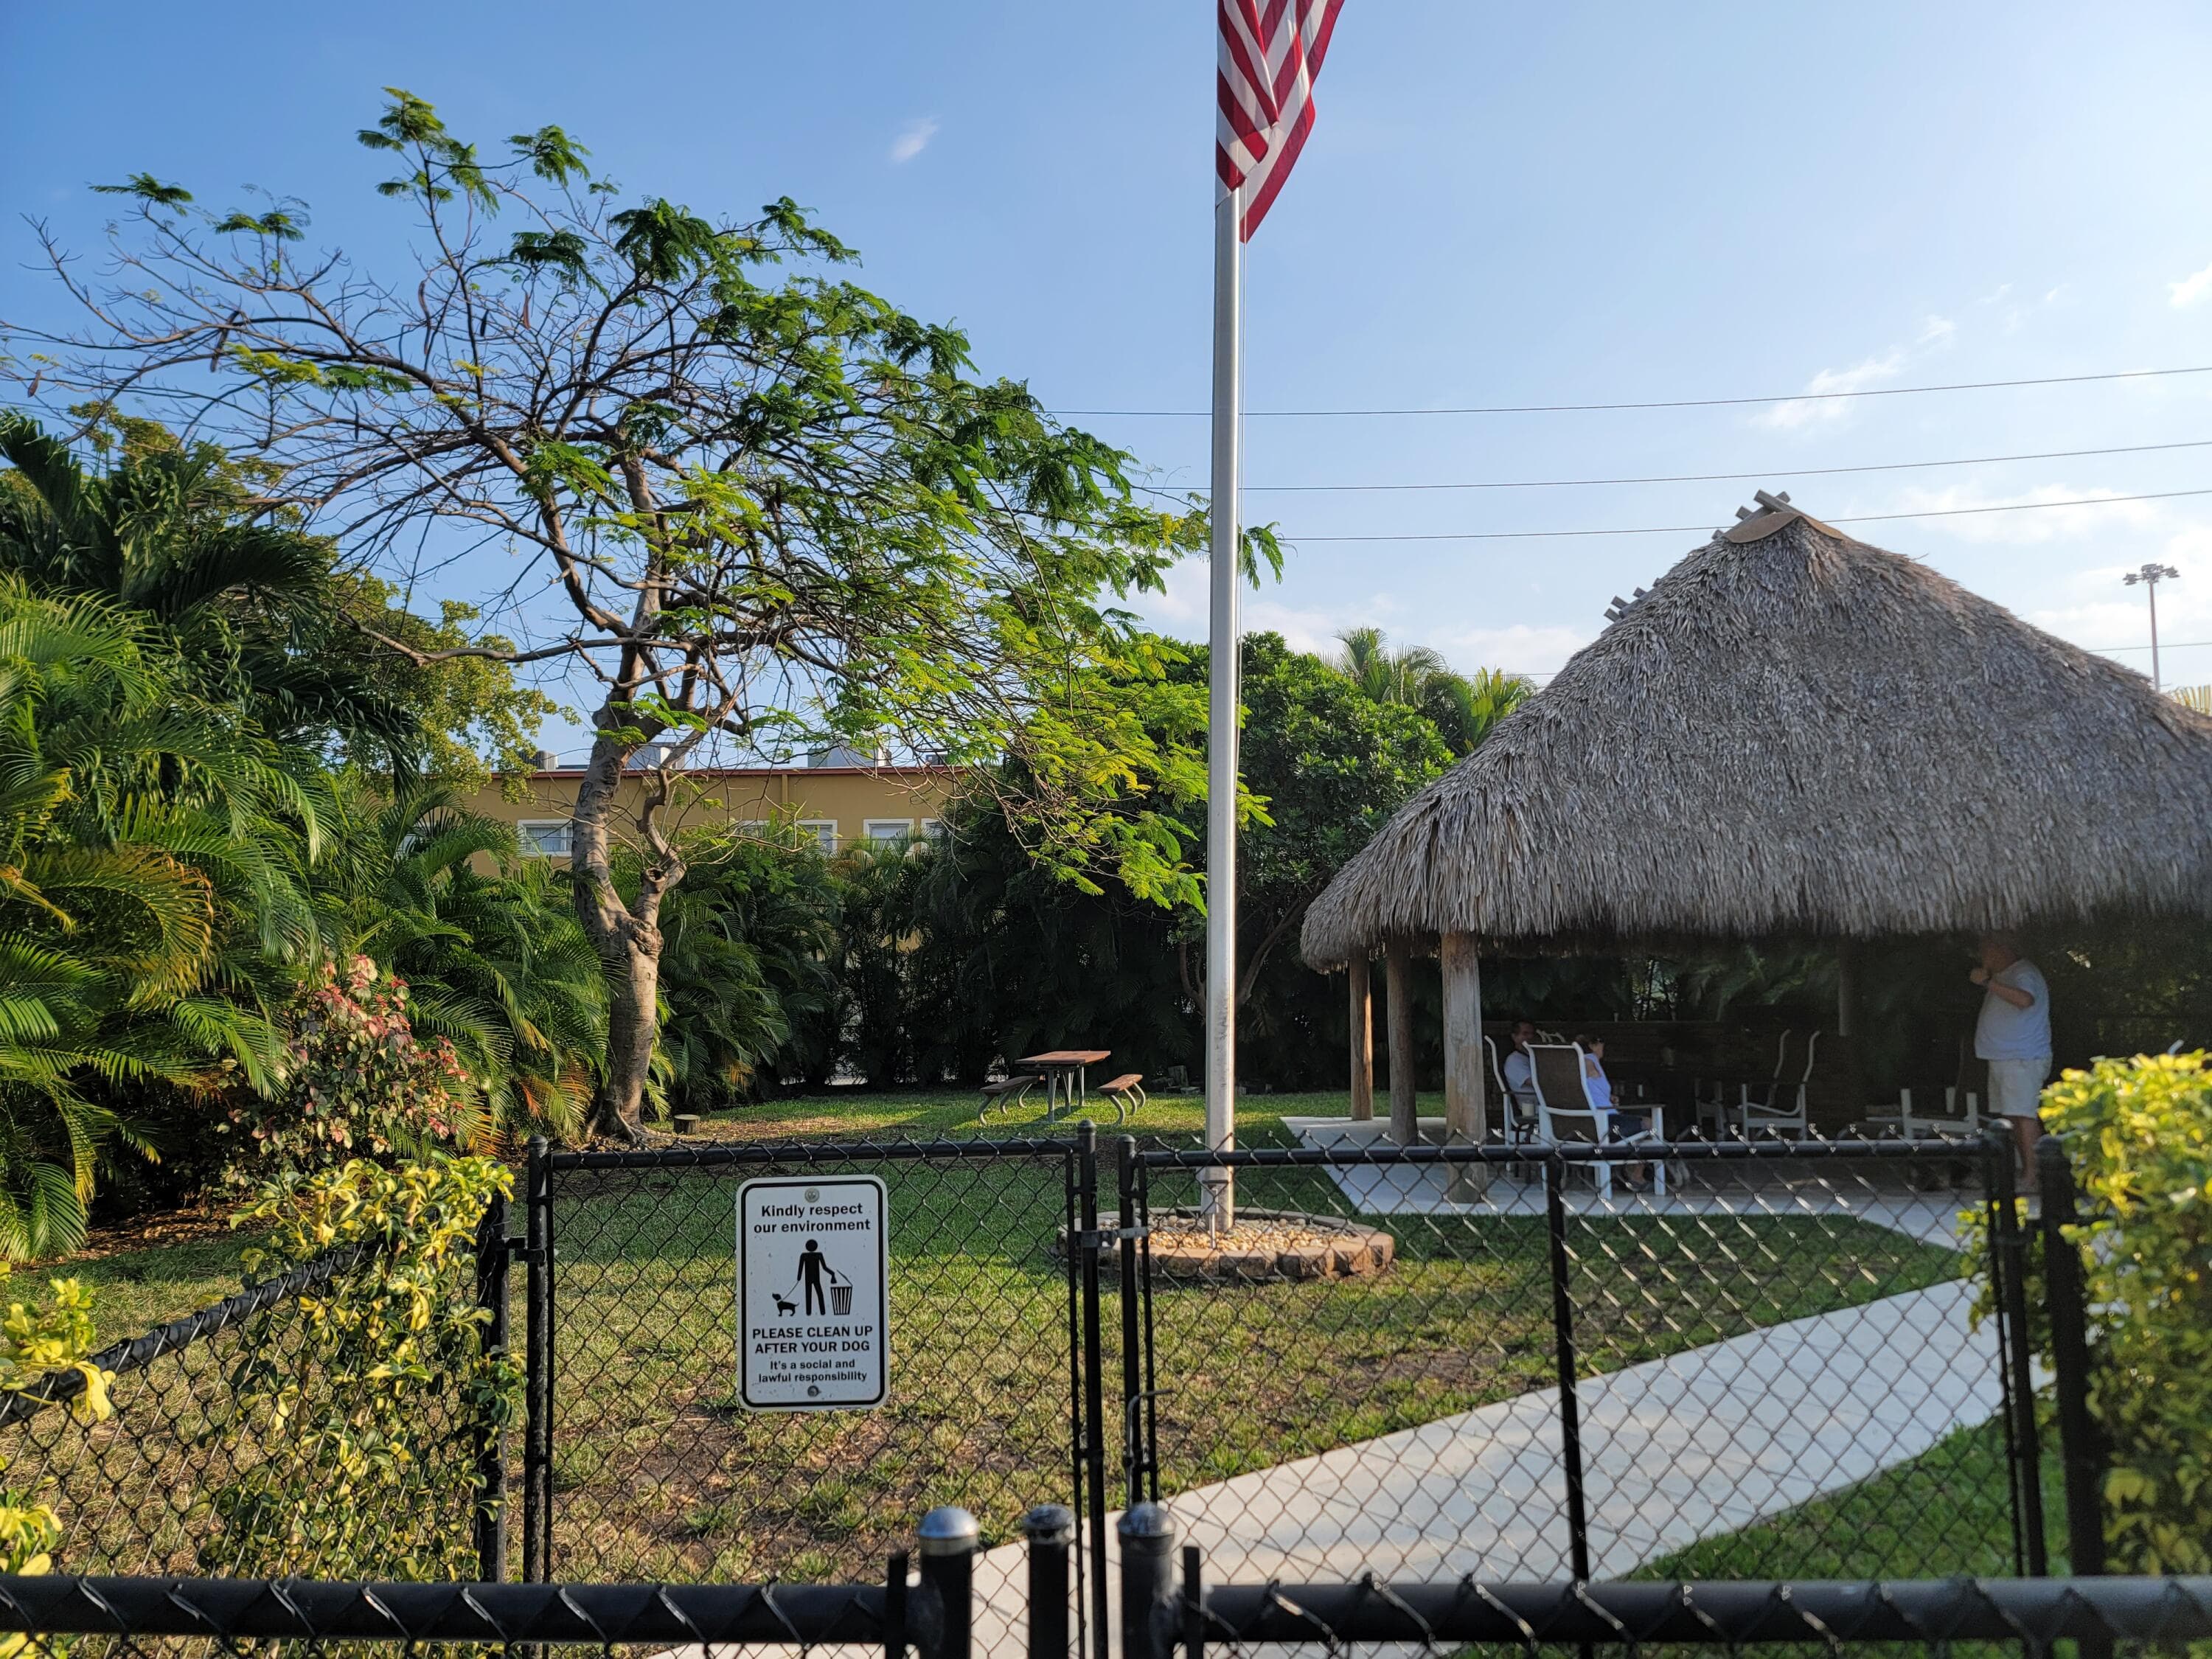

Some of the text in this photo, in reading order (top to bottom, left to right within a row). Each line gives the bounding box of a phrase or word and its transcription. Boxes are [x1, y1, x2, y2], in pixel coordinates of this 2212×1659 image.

[762, 1203, 863, 1218] Kindly respect
[754, 1219, 870, 1234] our environment
[753, 1326, 873, 1339] PLEASE CLEAN UP
[755, 1340, 869, 1354] AFTER YOUR DOG
[771, 1360, 787, 1370] It's
[800, 1359, 832, 1369] social
[835, 1359, 855, 1368] and
[758, 1370, 867, 1382] lawful responsibility
